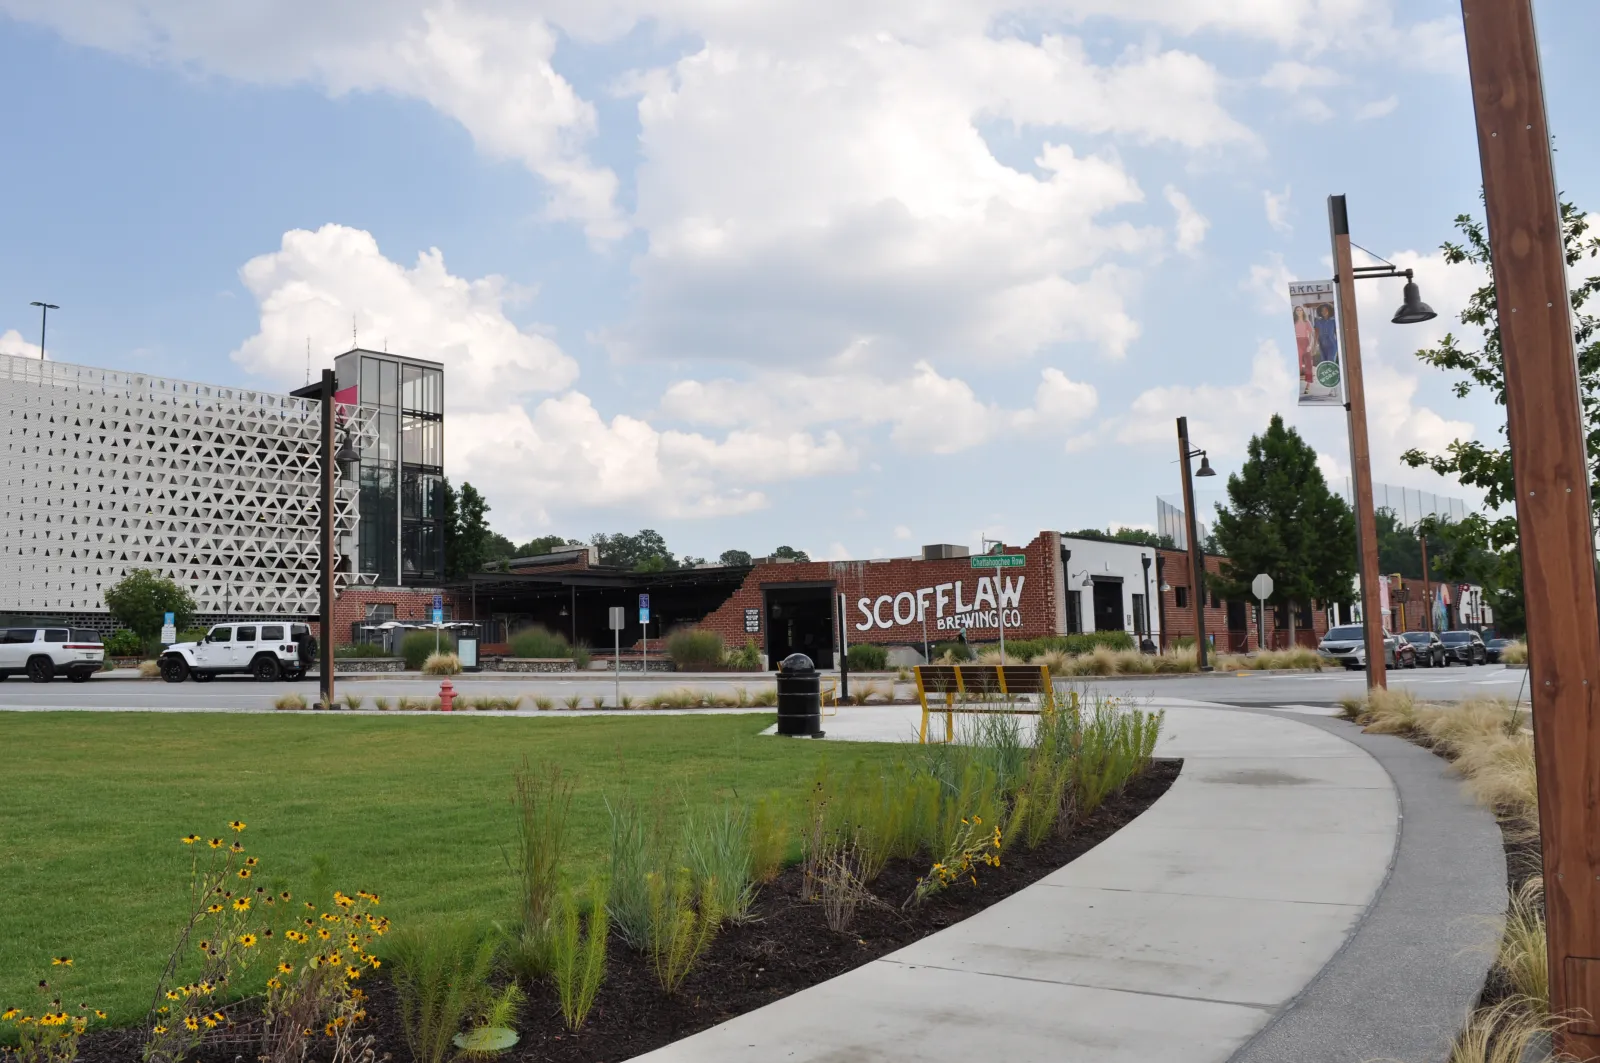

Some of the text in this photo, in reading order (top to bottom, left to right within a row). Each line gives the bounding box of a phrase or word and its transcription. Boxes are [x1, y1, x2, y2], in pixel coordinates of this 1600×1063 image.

[1320, 367, 1333, 376] THE
[972, 556, 1024, 567] Chattahoochee Row
[855, 575, 1026, 631] SCOFFLAW
[937, 609, 1024, 630] BREWING CO.
